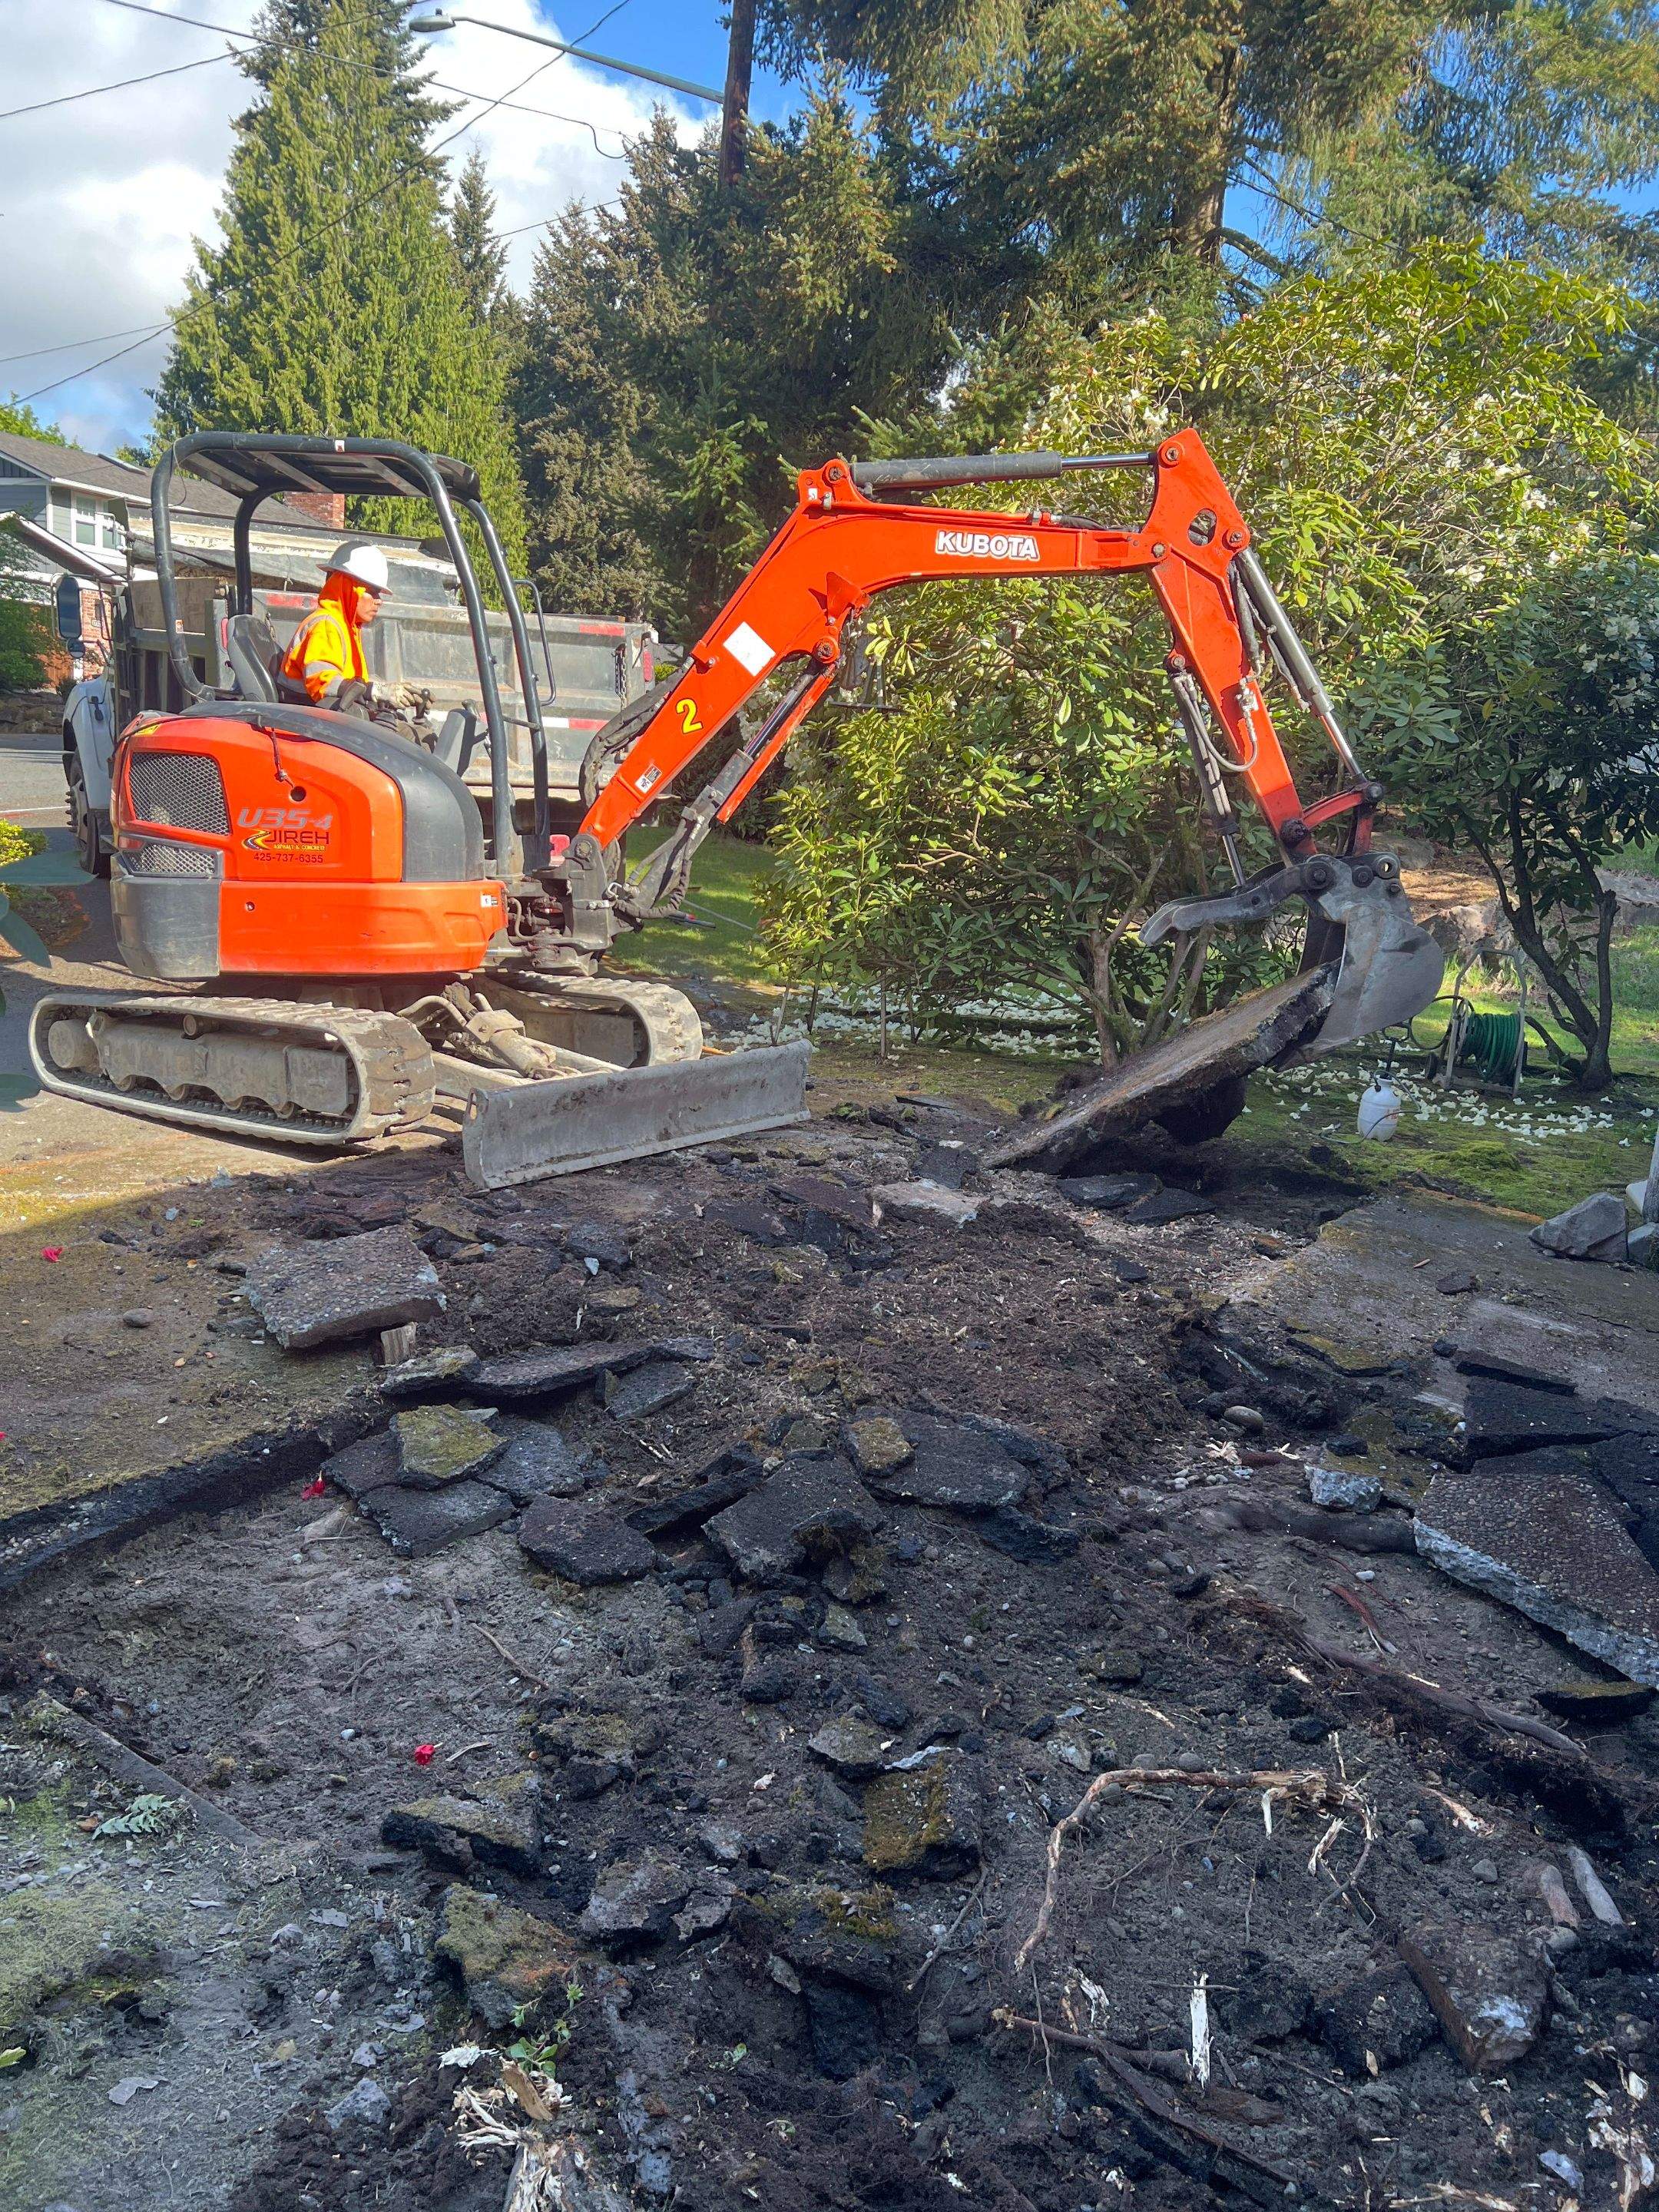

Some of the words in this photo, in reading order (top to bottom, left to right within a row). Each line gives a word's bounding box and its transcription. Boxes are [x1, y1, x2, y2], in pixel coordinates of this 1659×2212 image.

[936, 531, 1039, 559] KUBOTA
[676, 698, 704, 734] 2
[237, 807, 333, 829] U35-4
[265, 830, 329, 844] JIREH
[253, 853, 323, 863] 425-737-6355
